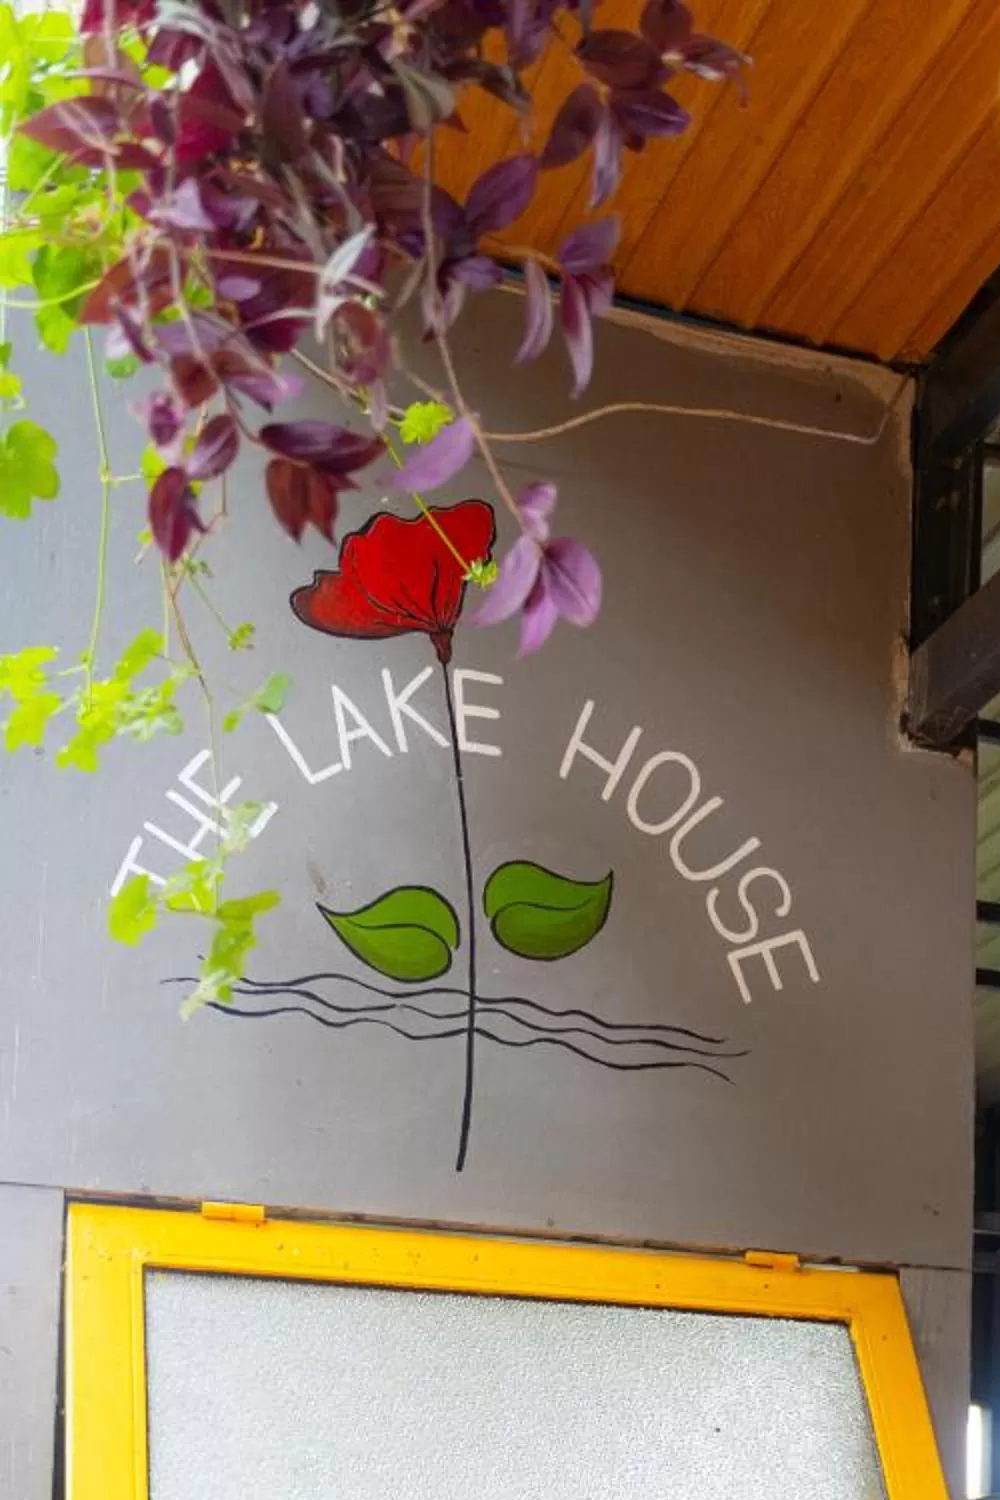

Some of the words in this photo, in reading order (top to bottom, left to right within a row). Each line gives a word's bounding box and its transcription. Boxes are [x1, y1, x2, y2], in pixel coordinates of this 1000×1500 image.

[110, 749, 279, 898] THE
[266, 666, 503, 784] LAKE
[558, 699, 820, 1004] HOUSE
